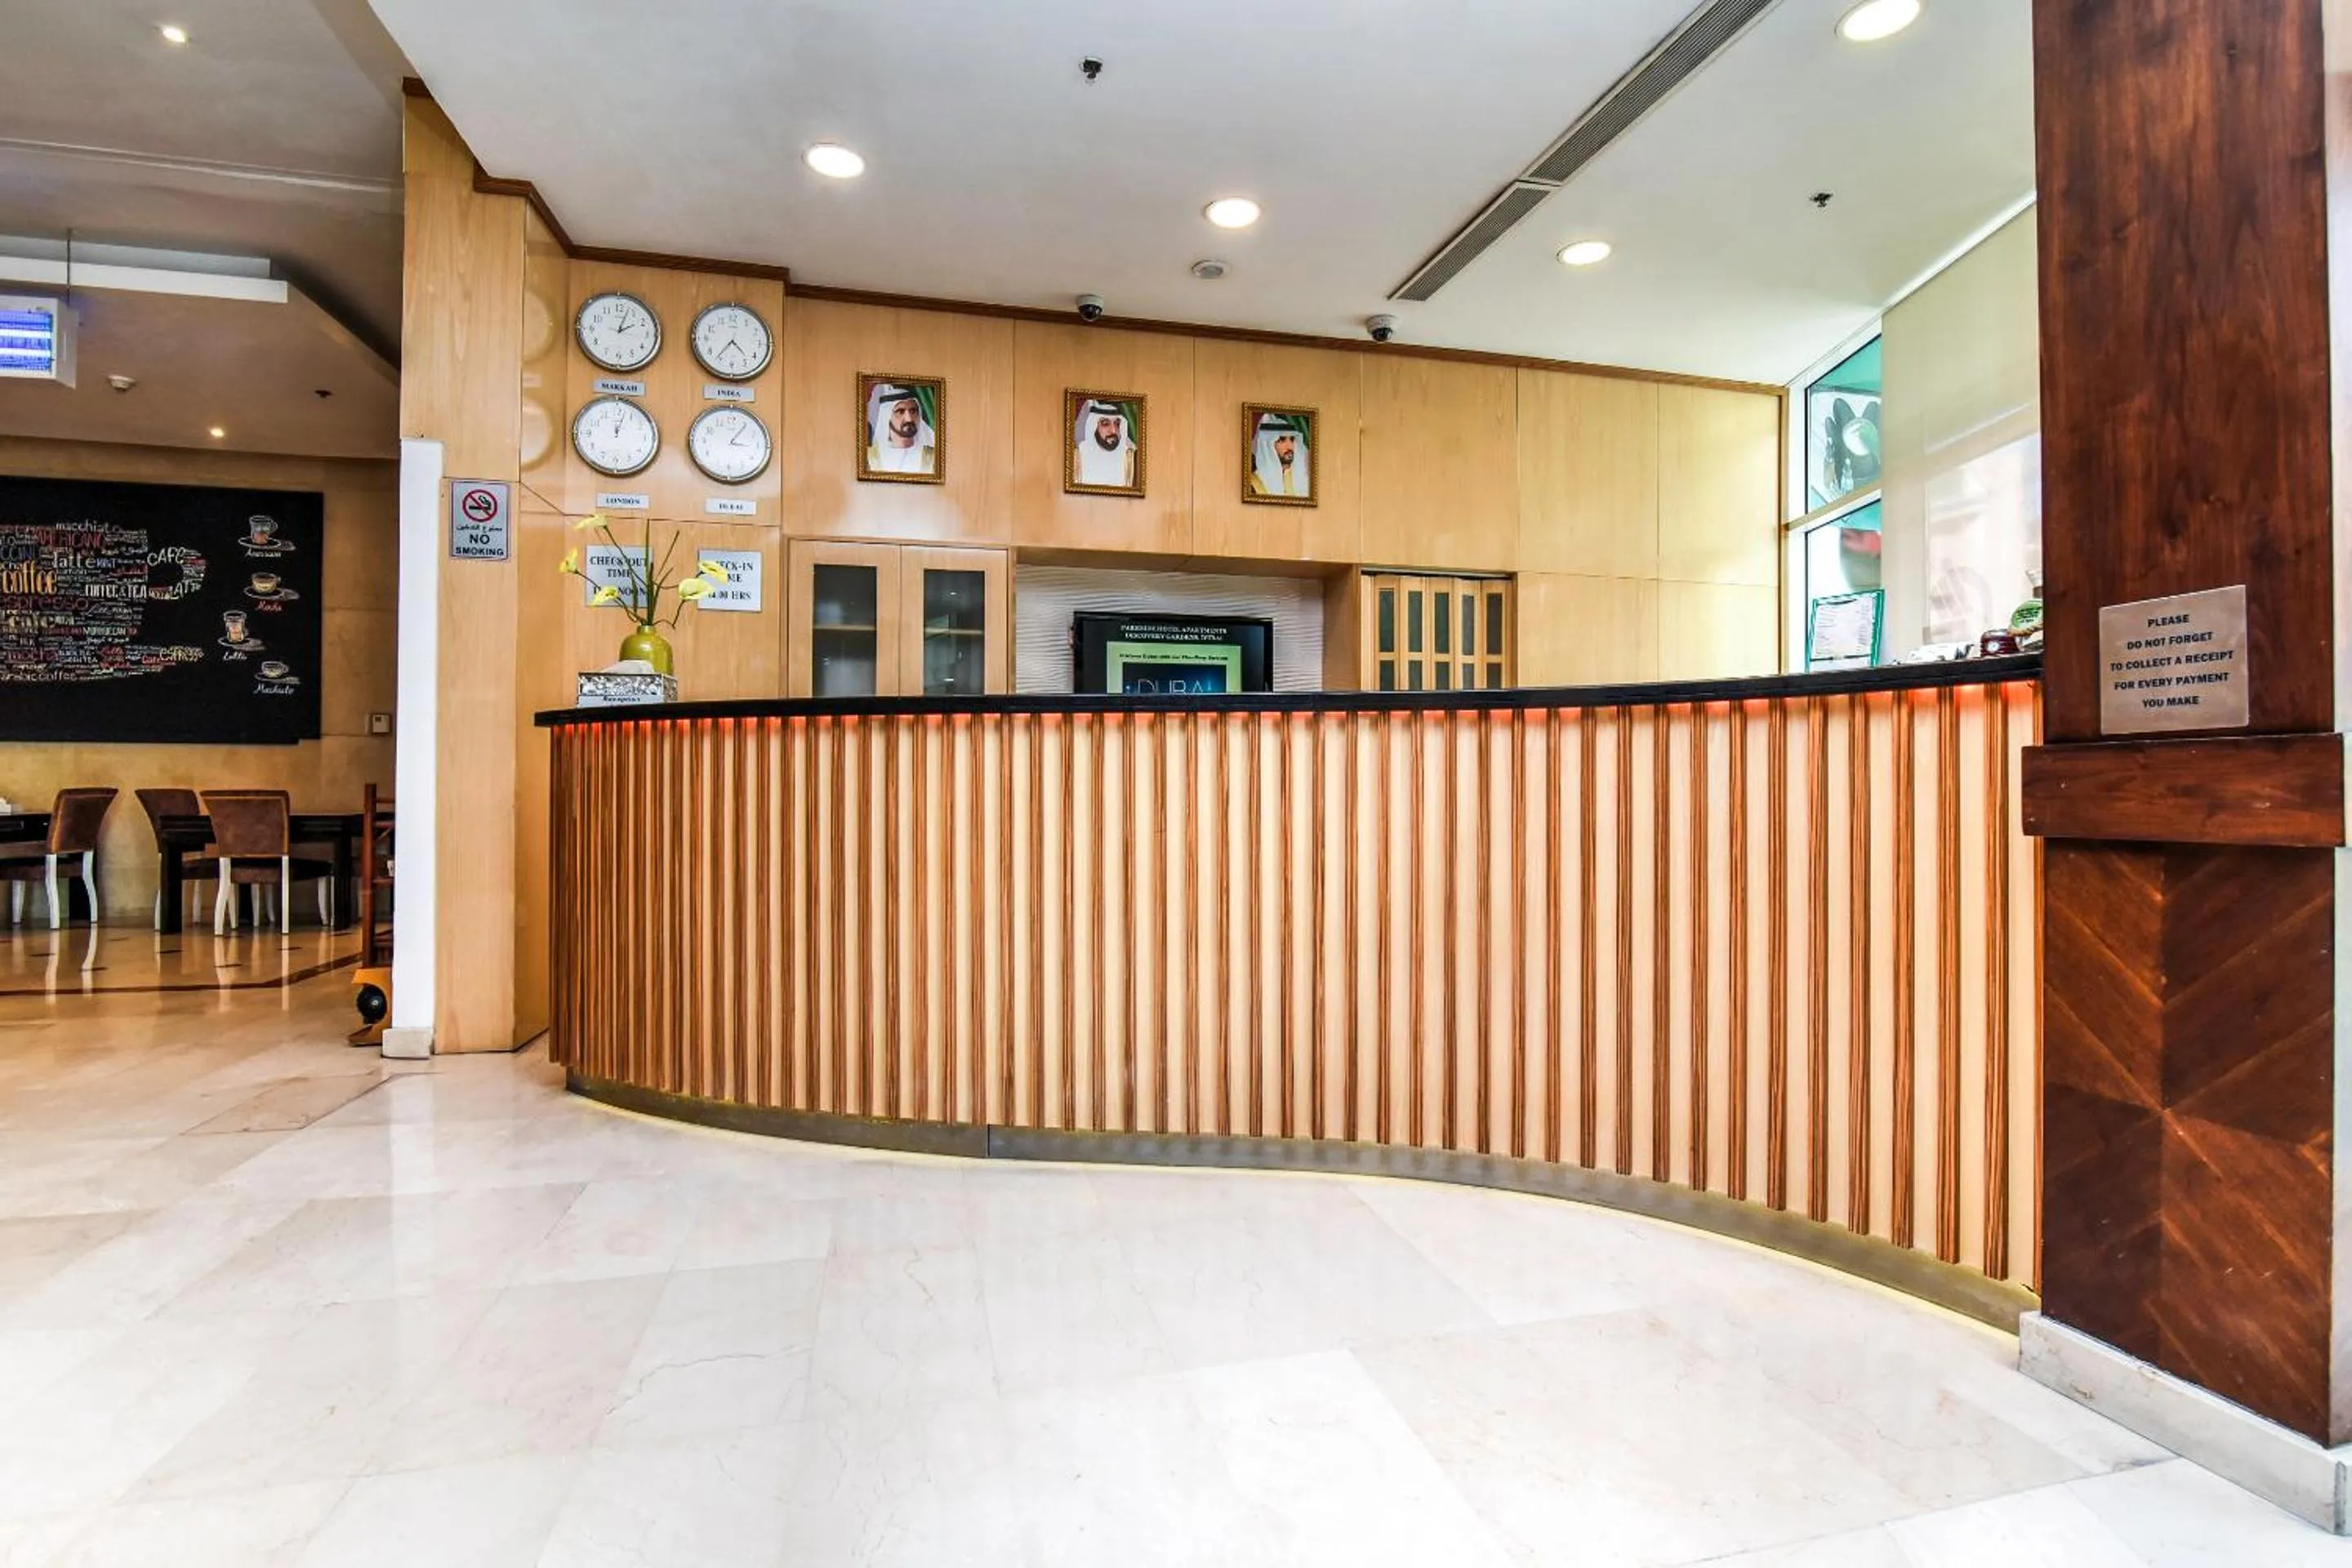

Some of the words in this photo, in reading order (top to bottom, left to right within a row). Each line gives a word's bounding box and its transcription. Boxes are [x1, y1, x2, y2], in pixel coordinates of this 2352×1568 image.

[717, 389, 742, 398] INDIA
[606, 497, 640, 506] LONDON
[470, 534, 490, 545] NO
[456, 546, 504, 556] SMOKING
[2, 560, 57, 595] coffee
[731, 590, 752, 600] HRS
[2147, 614, 2189, 627] PLEASE
[2127, 640, 2142, 650] DO
[2145, 638, 2166, 648] NOT
[2169, 631, 2214, 645] FORGET
[2110, 662, 2123, 671] TO
[2126, 657, 2172, 670] COLLECT
[2174, 656, 2183, 666] A
[2185, 650, 2234, 663] RECEIPT
[2114, 680, 2135, 690] FOR
[2138, 677, 2172, 689] EVERY
[2176, 672, 2230, 685] PAYMENT
[2142, 698, 2164, 708] YOU
[2167, 695, 2200, 706] MAKE
